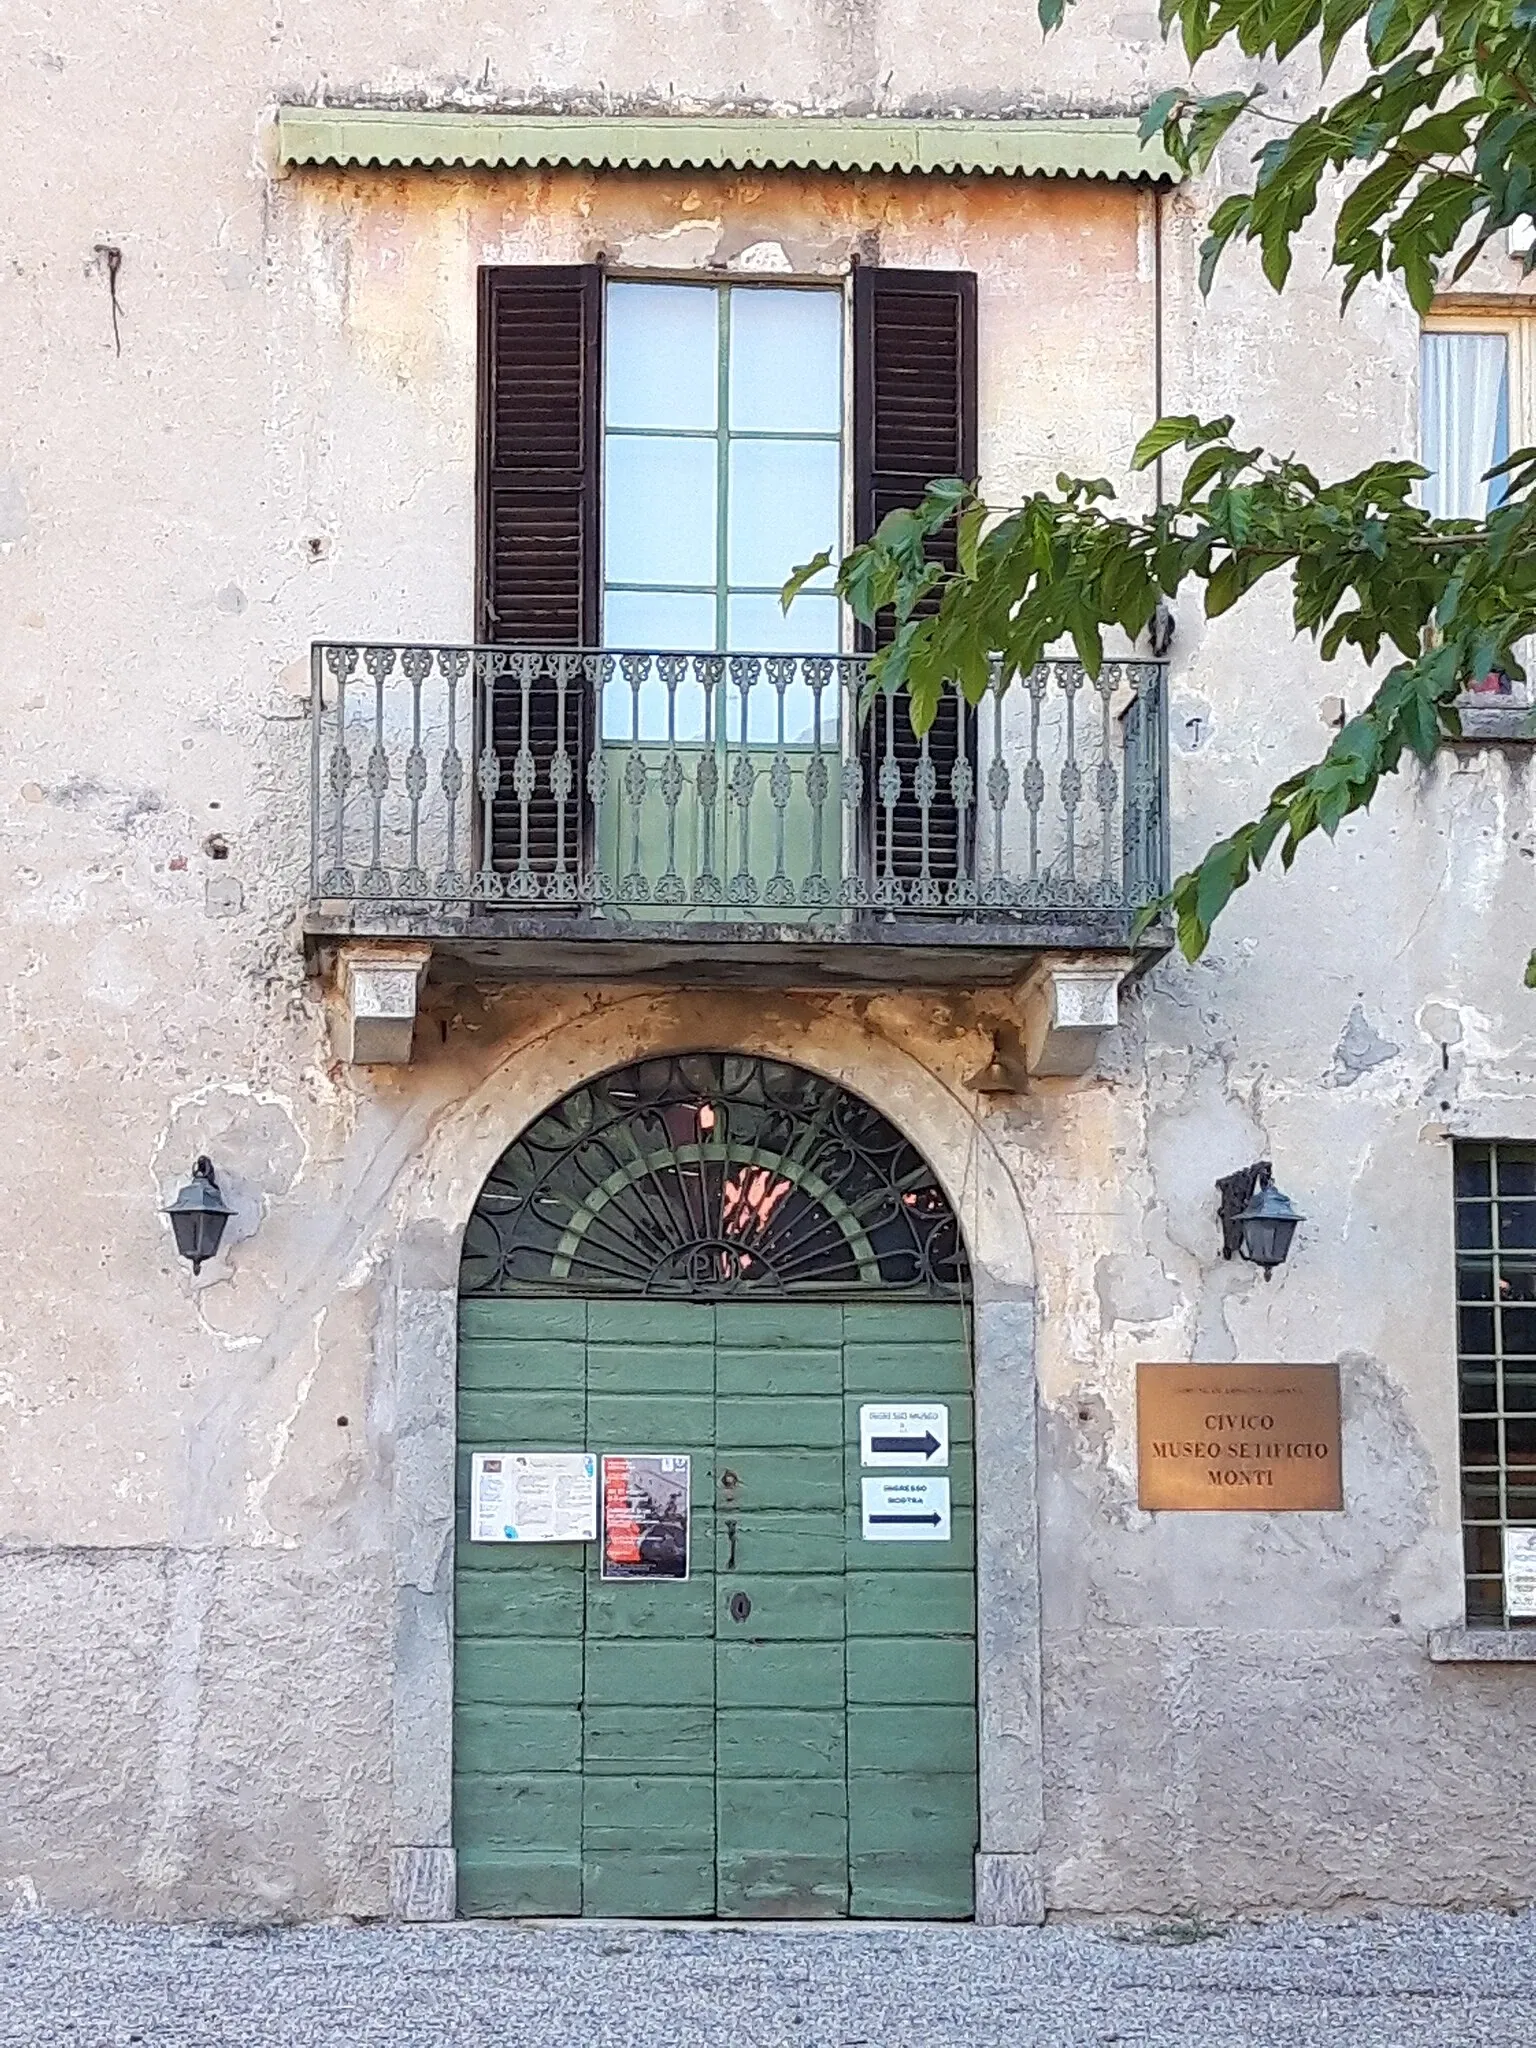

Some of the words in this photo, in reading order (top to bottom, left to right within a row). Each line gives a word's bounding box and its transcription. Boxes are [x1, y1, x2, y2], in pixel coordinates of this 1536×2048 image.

[1204, 1414, 1274, 1430] CIVICO
[1152, 1442, 1221, 1459] MUSEO
[1227, 1442, 1329, 1459] SETIFICIO
[1207, 1470, 1273, 1486] MONTI
